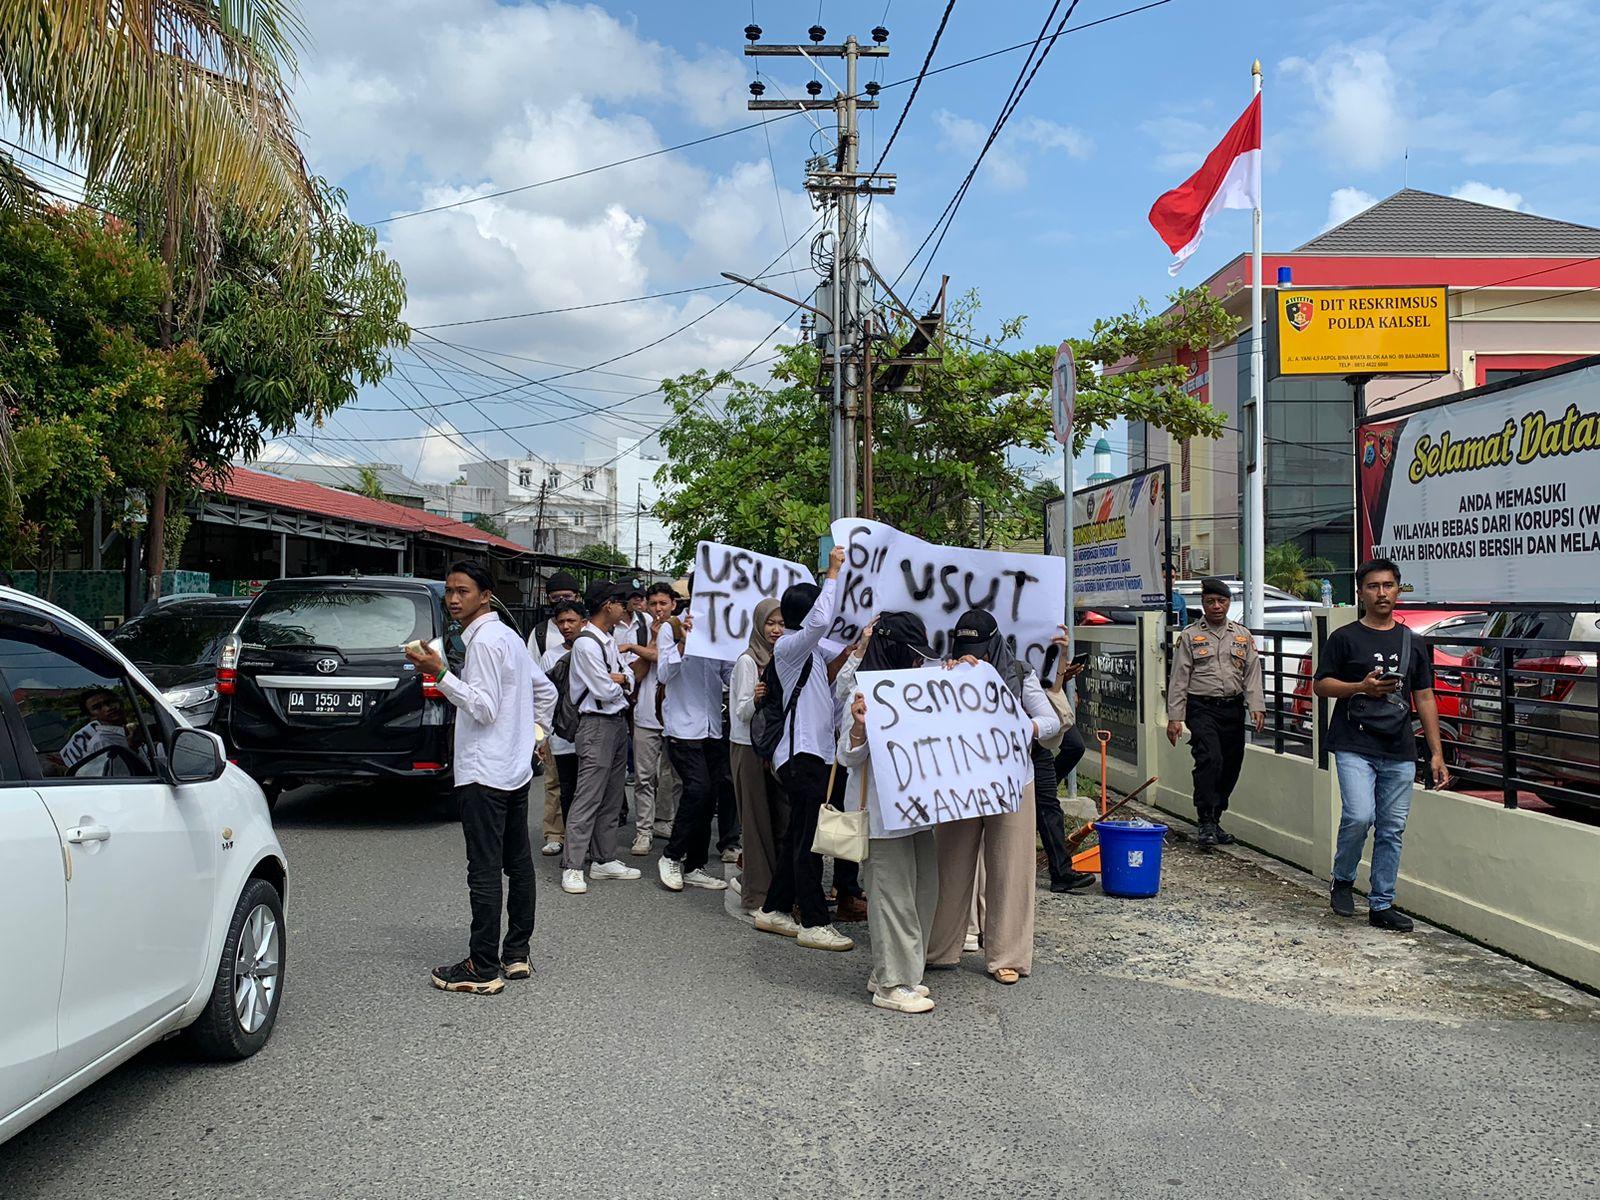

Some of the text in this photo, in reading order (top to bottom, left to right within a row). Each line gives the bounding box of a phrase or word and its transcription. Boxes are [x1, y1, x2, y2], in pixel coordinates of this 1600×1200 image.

[1320, 296, 1438, 311] DIT RESKRIMSUS
[1328, 316, 1431, 330] POLDA KALSEL
[1408, 418, 1516, 484] Selamat
[1458, 482, 1566, 514] ANDA MEMASUKI
[1393, 523, 1439, 541] WILAYAH
[1442, 518, 1479, 537] BEBAS
[1482, 513, 1511, 533] DARI
[1514, 508, 1574, 531] KORUPSI
[1372, 544, 1415, 562] WILAYAH
[1418, 541, 1476, 560] BIROKRASI
[1479, 536, 1523, 558] BERSIH
[1527, 534, 1556, 554] DAN
[900, 559, 1040, 622] USUT
[291, 693, 362, 706] DA 1550 JG
[872, 679, 1019, 730] Semoga
